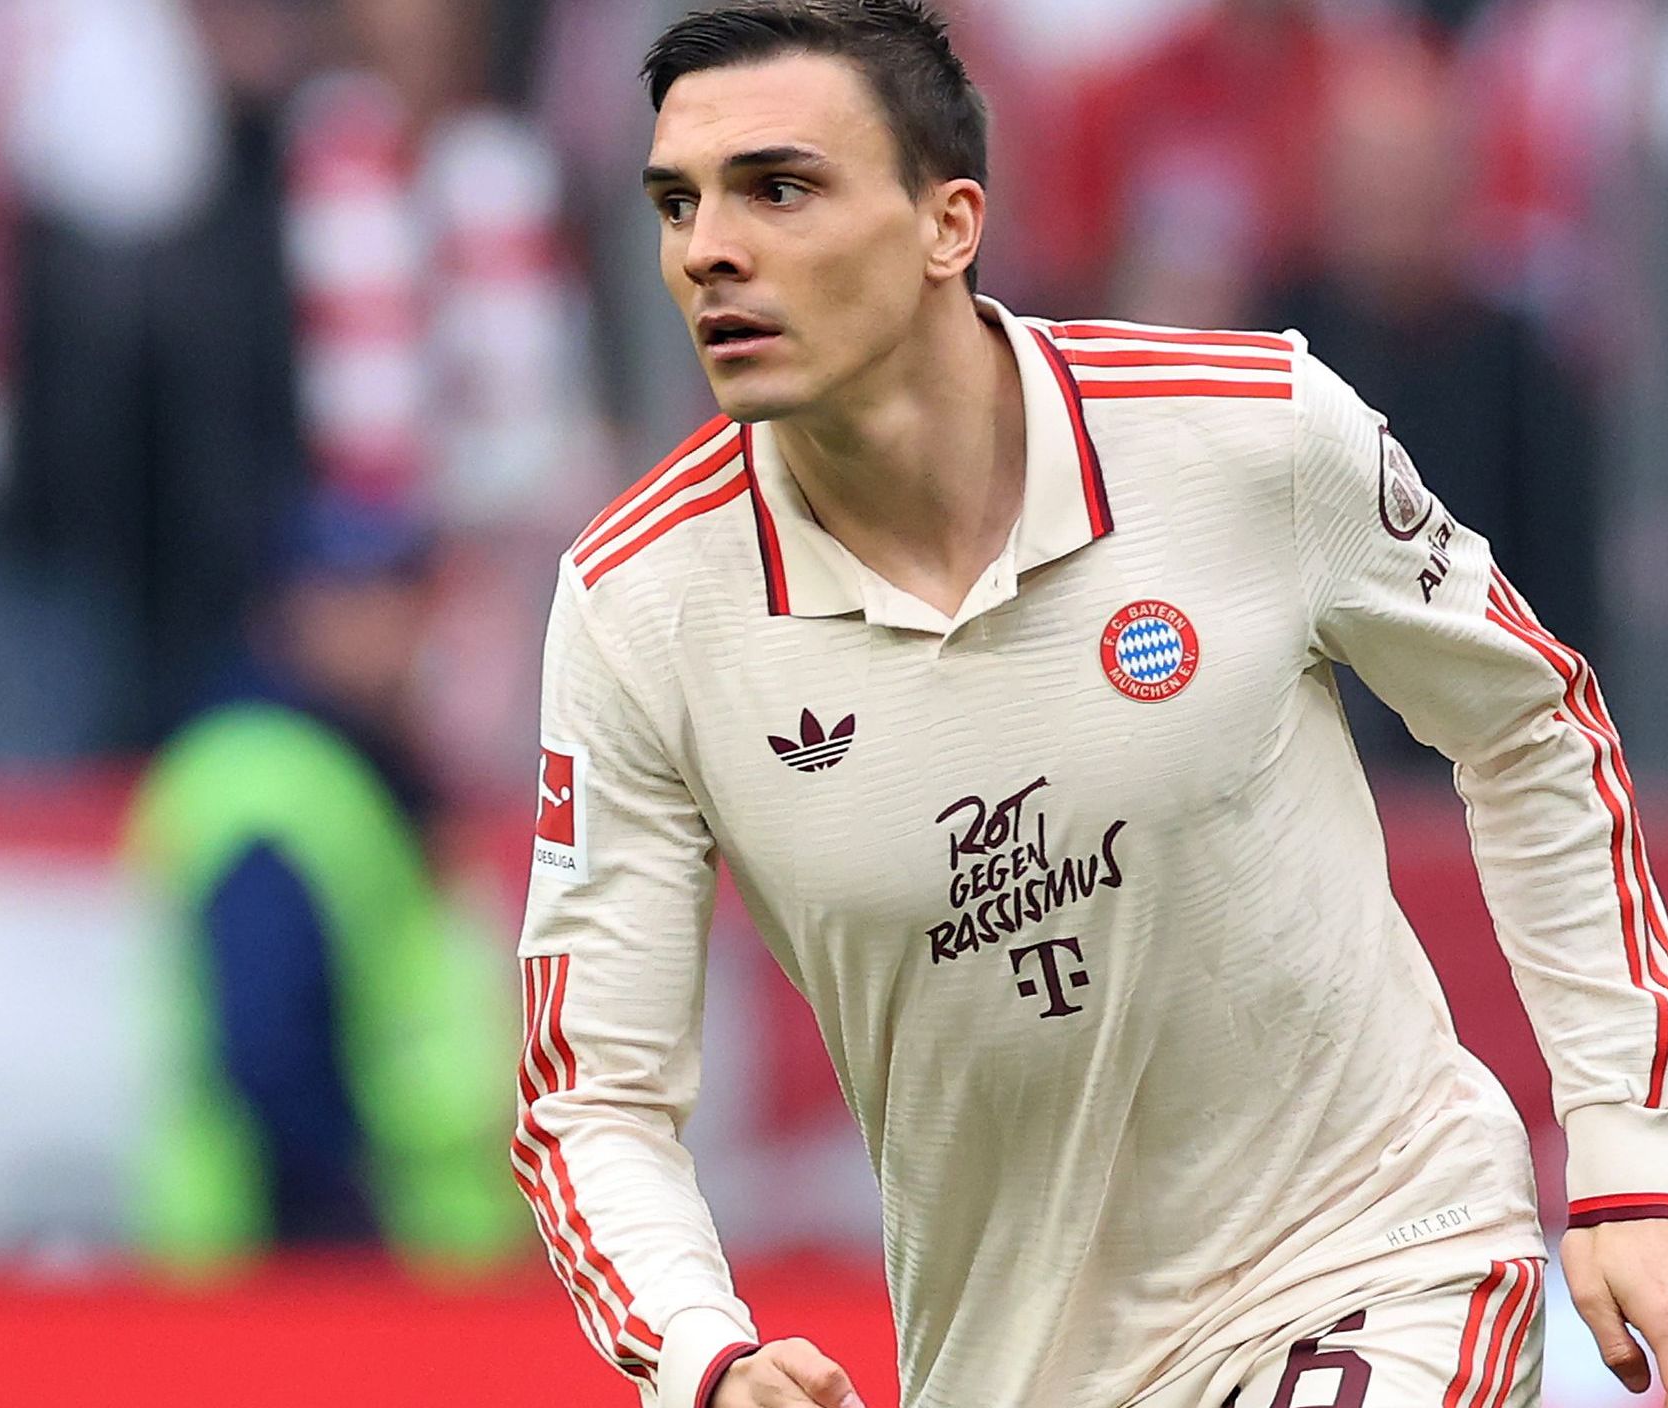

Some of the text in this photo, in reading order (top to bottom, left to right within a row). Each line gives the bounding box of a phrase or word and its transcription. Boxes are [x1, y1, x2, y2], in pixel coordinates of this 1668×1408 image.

[1415, 510, 1456, 605] Allia
[1127, 603, 1187, 630] BAYERN
[535, 848, 577, 871] DESLIGA
[935, 776, 1051, 871] ROT
[950, 812, 1049, 909] GEGEN
[926, 819, 1127, 964] RASSISMUS
